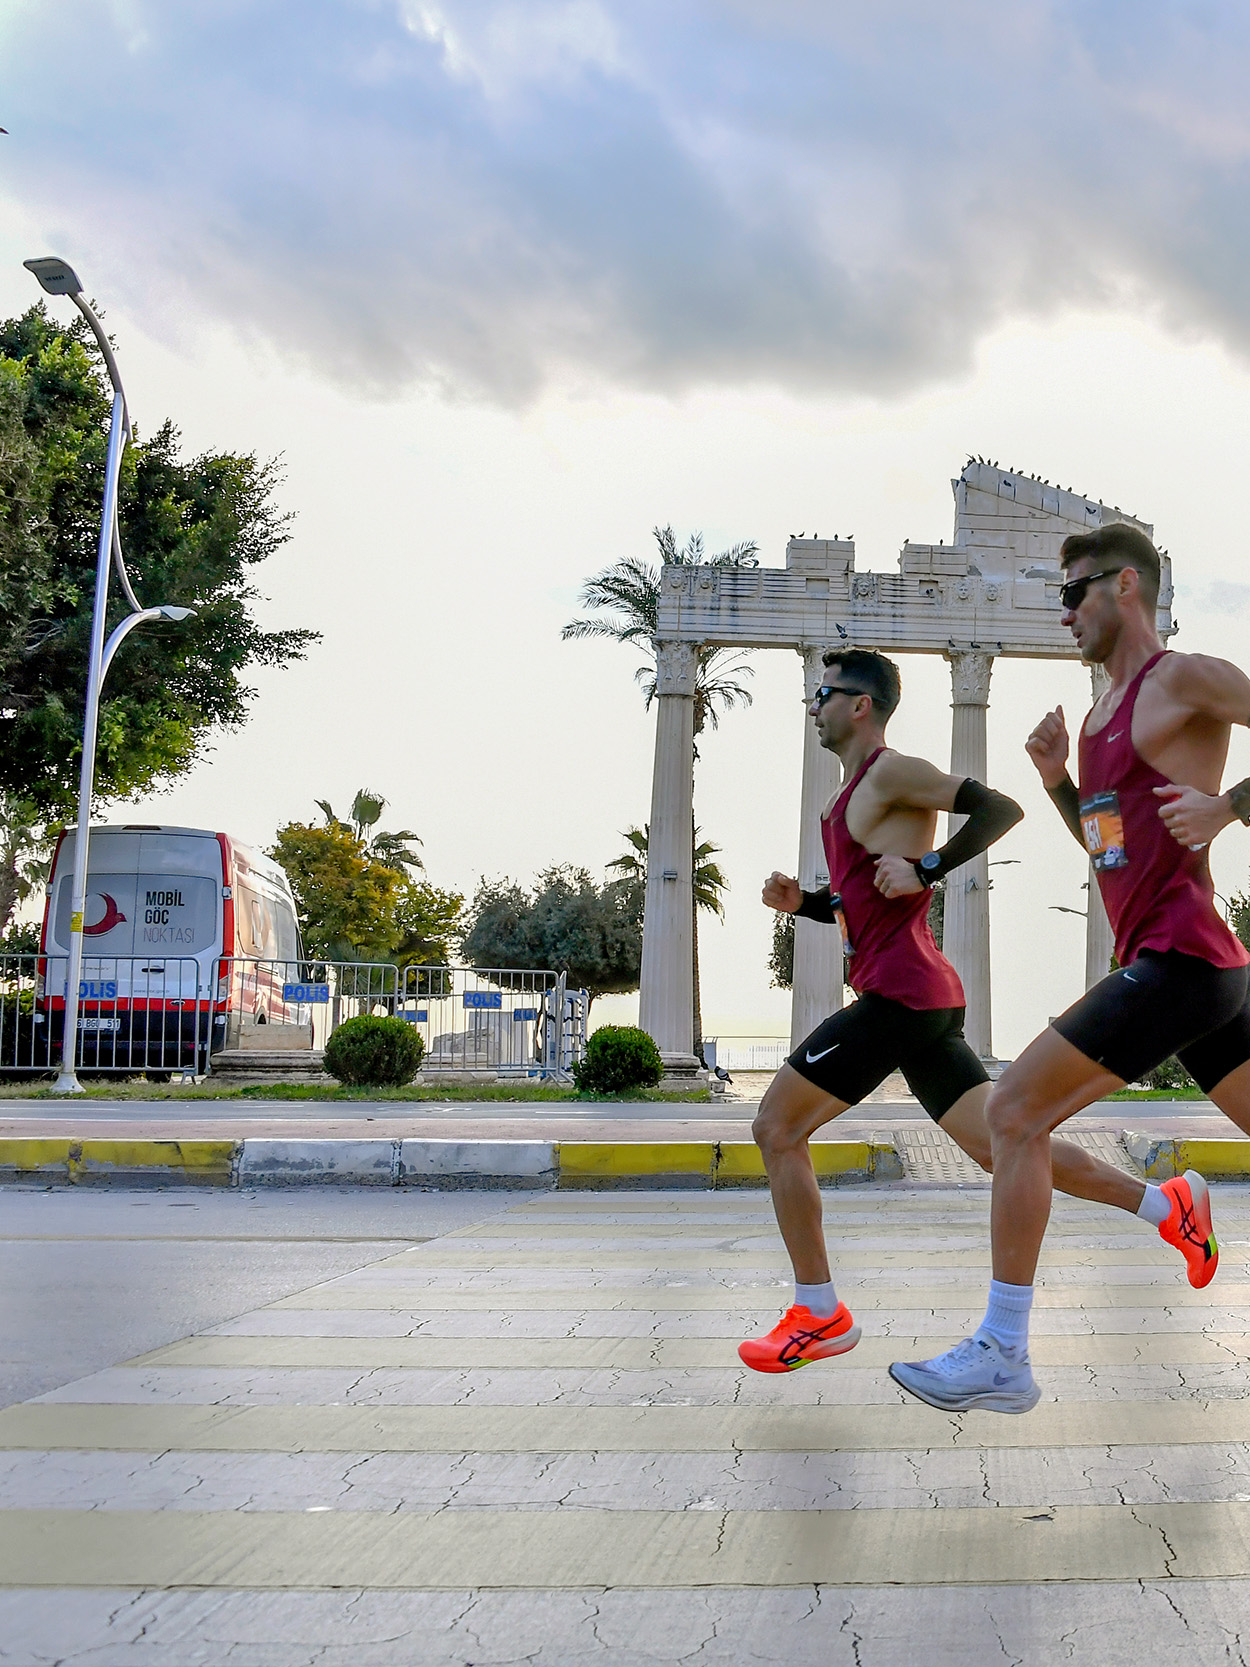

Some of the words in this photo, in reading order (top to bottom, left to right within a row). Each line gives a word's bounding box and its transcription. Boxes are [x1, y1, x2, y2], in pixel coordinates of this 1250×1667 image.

[145, 889, 185, 906] MOBİL
[144, 906, 169, 926] GÖÇ
[143, 927, 195, 944] NOKTASI
